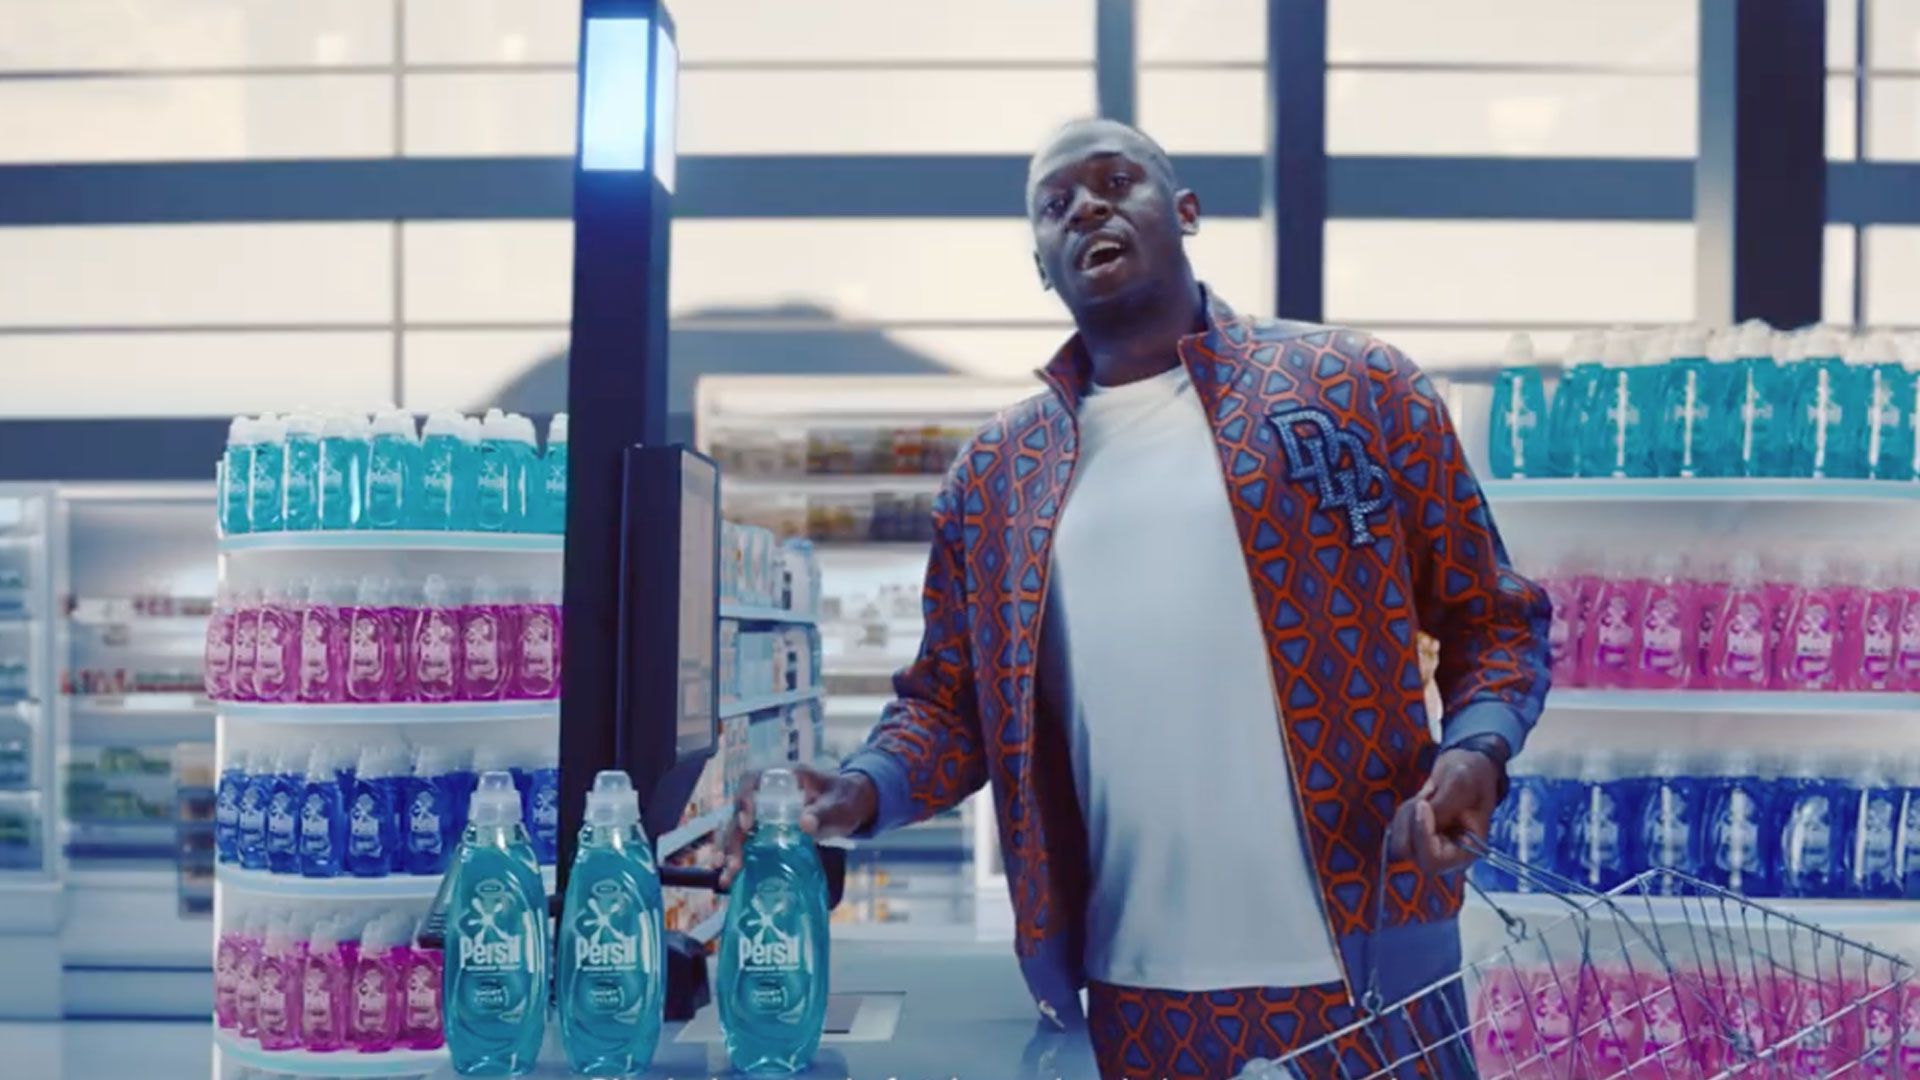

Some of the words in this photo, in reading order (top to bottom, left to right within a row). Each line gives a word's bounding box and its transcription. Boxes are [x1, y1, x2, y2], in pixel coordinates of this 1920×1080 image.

[459, 933, 521, 968] Persil
[575, 933, 637, 968] Persil
[739, 934, 800, 968] Persil
